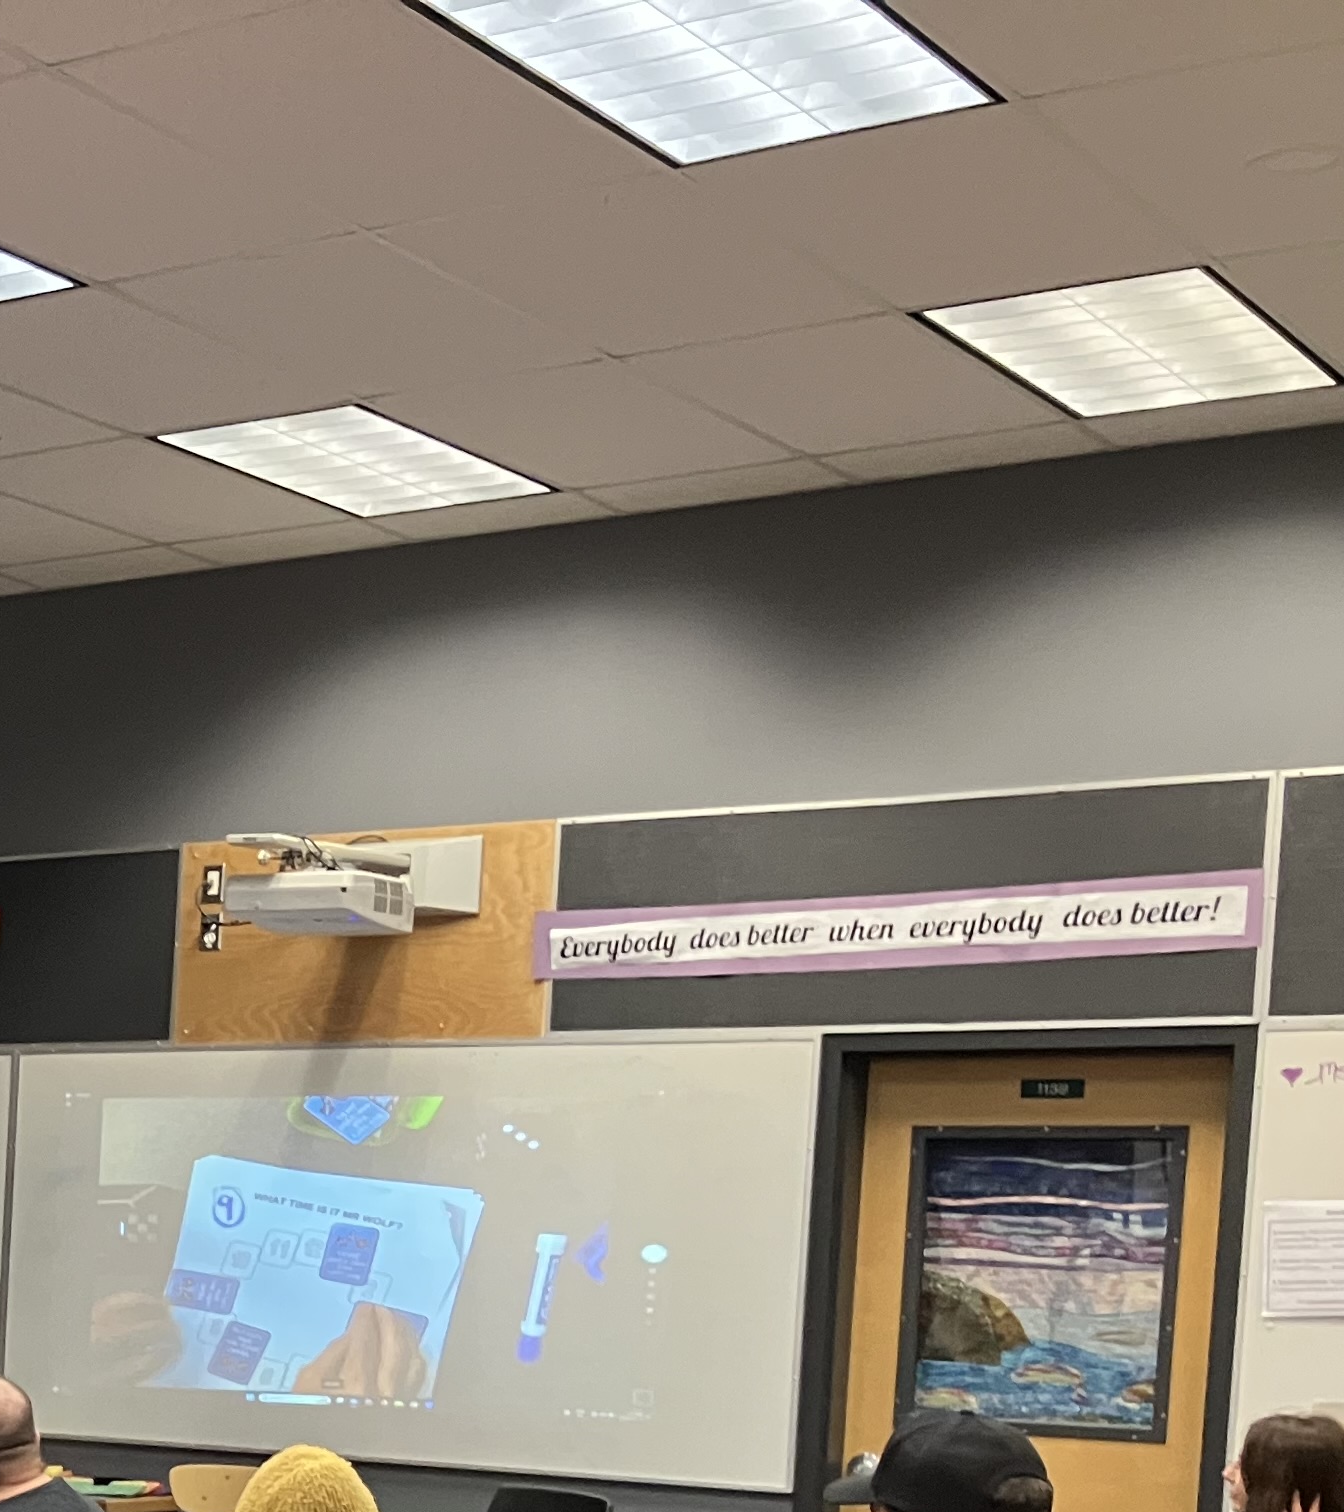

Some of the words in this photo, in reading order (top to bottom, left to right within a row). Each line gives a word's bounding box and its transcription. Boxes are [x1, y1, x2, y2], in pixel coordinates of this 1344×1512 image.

[560, 931, 677, 964] Everybody
[689, 928, 740, 950] does
[747, 925, 814, 945] better
[828, 919, 895, 942] when
[909, 910, 1044, 945] everybody
[1062, 905, 1123, 928] does
[1130, 896, 1223, 925] better!
[254, 1192, 286, 1206] WHAT
[290, 1198, 313, 1212] TIME
